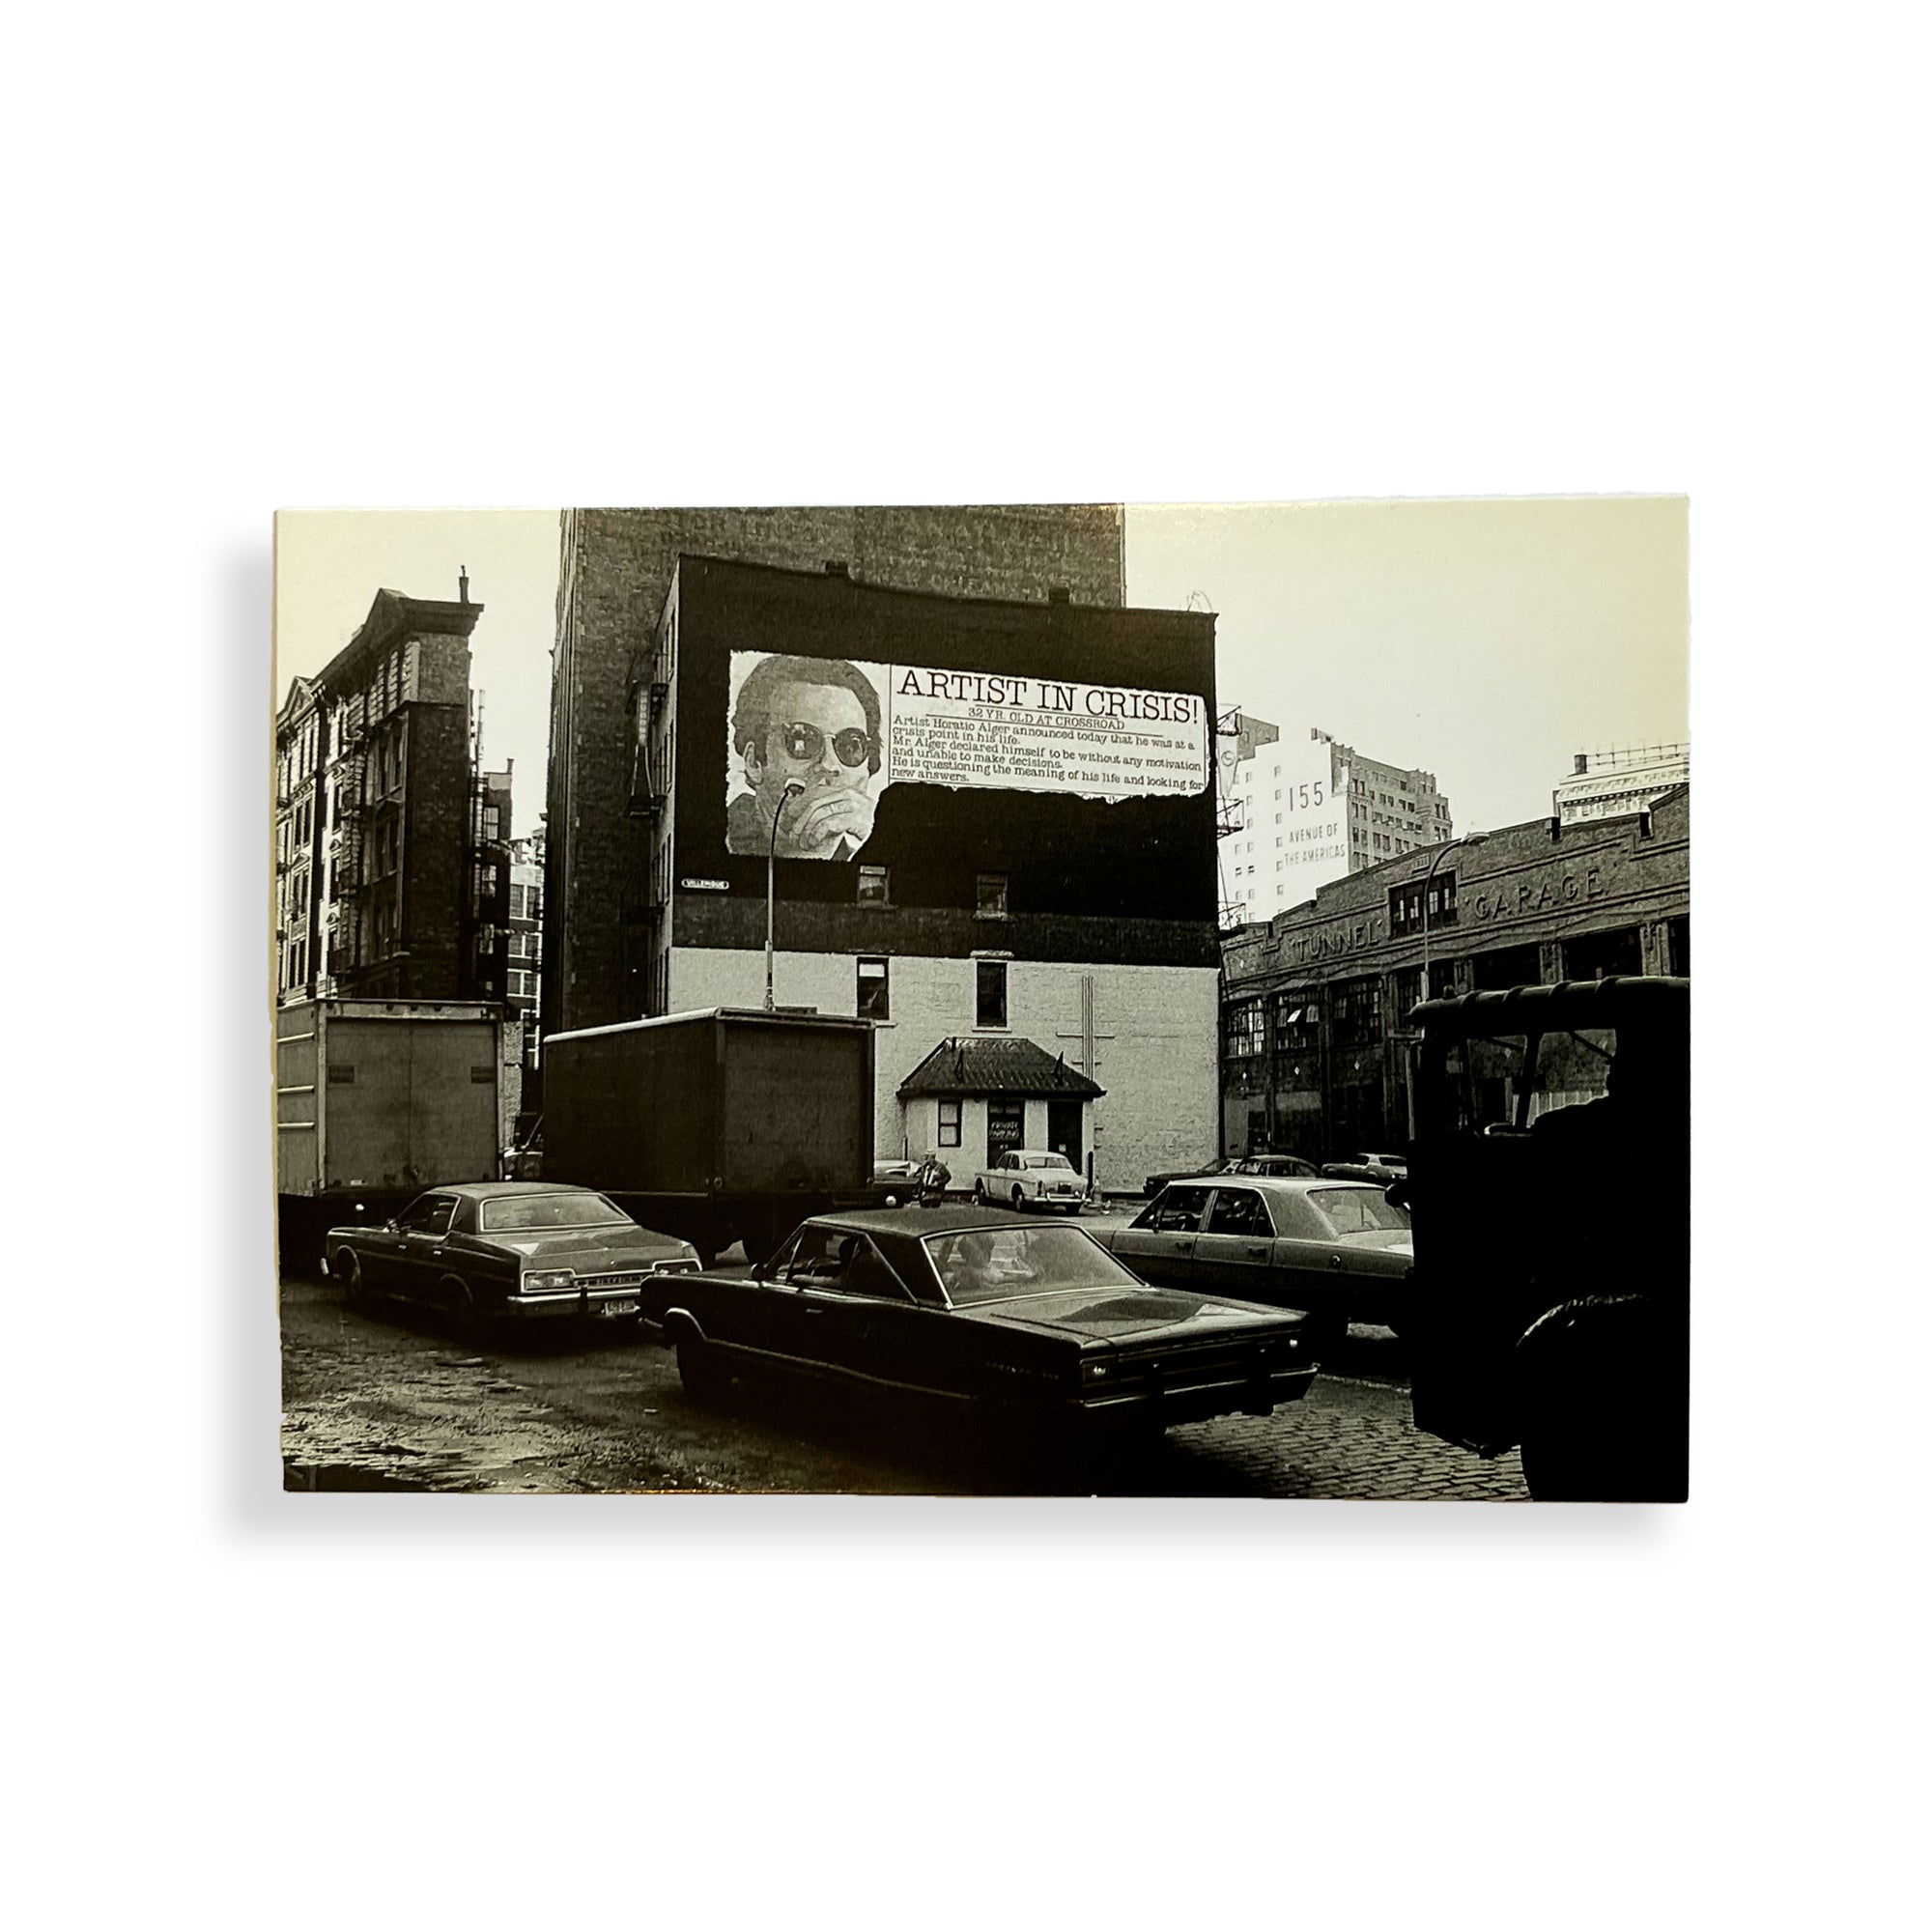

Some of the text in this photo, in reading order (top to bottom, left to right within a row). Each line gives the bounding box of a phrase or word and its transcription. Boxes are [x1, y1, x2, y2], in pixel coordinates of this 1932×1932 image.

[896, 669, 1198, 724] ARTIST IN CRISIS!
[968, 707, 983, 718] 32
[1009, 711, 1034, 724] OLD
[1037, 715, 1052, 724] AT
[1055, 717, 1124, 730] CROSSROAD
[893, 726, 1020, 745] crisis point in his life.
[894, 715, 929, 726] Artist
[933, 719, 975, 731] Horatio
[979, 723, 1009, 737] Alger
[1012, 726, 1074, 739] announced
[1077, 731, 1107, 745] today
[1111, 734, 1133, 745] that
[1136, 736, 1149, 747] he
[1175, 740, 1186, 750] at
[892, 747, 1063, 769] and unable to make decisions.
[915, 737, 947, 751] Alger
[950, 741, 998, 753] declared
[1002, 745, 1045, 756] himself
[1049, 749, 1061, 758] to
[1063, 749, 1075, 759] be
[1078, 751, 1121, 764] without
[1122, 757, 1143, 768] any
[1146, 758, 1202, 771] motivation
[892, 768, 970, 781] new answers.
[893, 756, 1204, 790] He is questioning the meaning of his life and looking for
[1290, 781, 1322, 811] 155
[1289, 823, 1338, 843] AVENUE OF
[1284, 844, 1346, 866] THE AMERICAS
[1475, 868, 1604, 920] GARAGE
